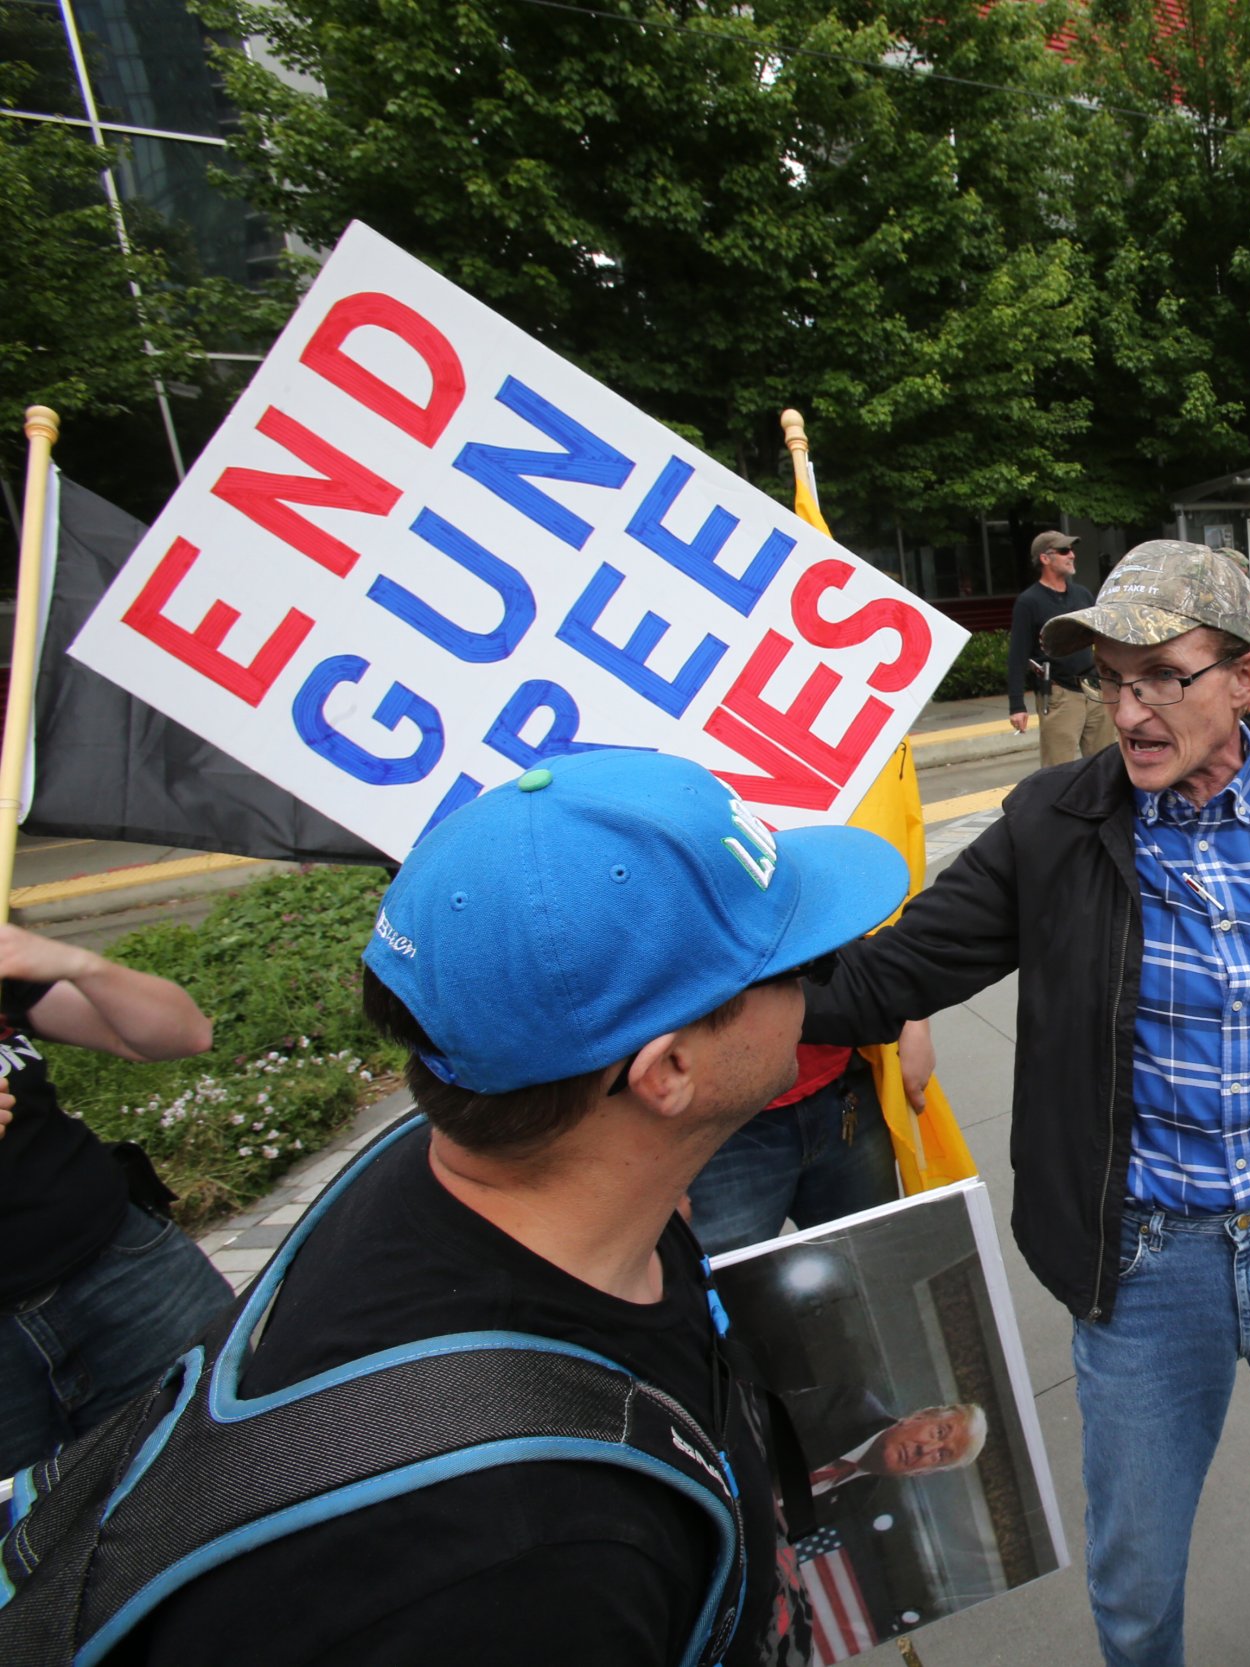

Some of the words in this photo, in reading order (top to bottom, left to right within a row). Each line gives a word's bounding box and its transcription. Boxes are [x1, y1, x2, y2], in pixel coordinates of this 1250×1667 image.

[121, 291, 467, 708] END
[290, 374, 637, 786] GUN
[411, 454, 798, 849] REE
[704, 559, 933, 833] NES
[1122, 584, 1146, 593] TAKE
[1147, 585, 1160, 595] IT
